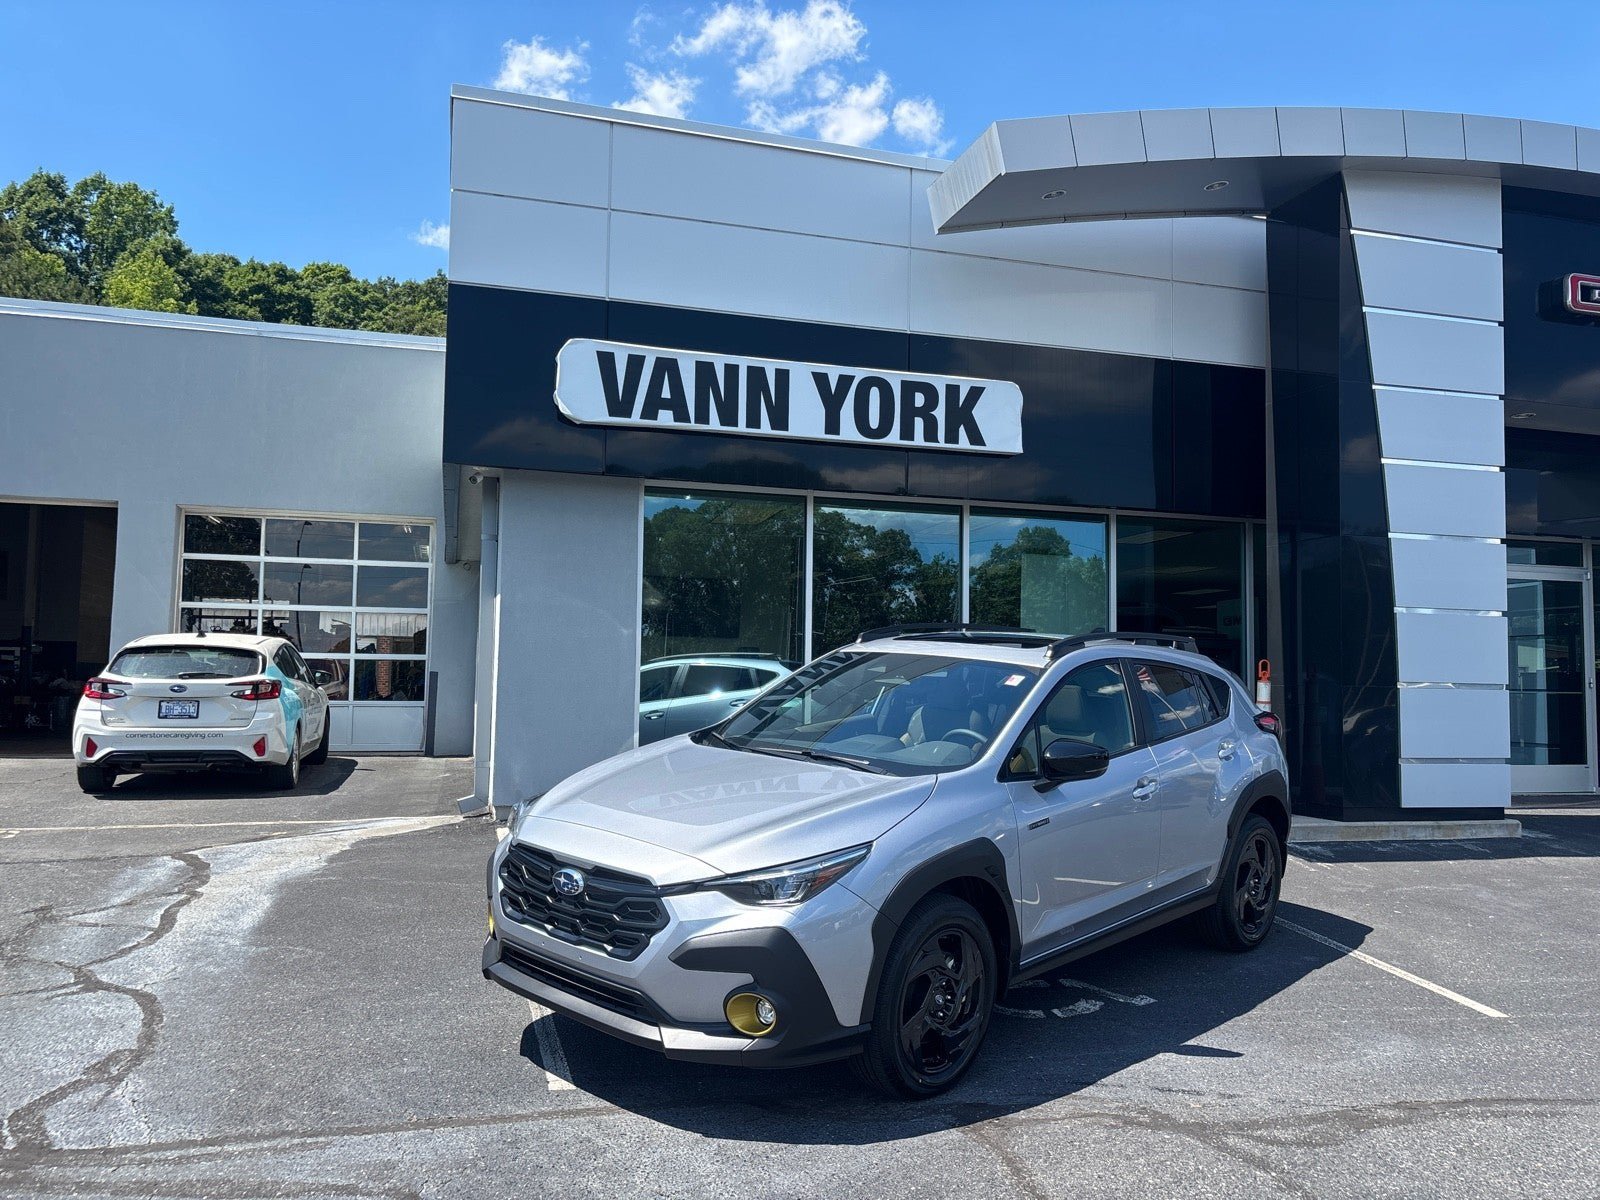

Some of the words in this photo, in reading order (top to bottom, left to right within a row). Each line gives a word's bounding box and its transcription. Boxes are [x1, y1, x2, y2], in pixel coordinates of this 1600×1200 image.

[596, 350, 790, 432] VANN
[811, 371, 987, 447] YORK
[125, 731, 224, 740] cornerstonecaregivingcom
